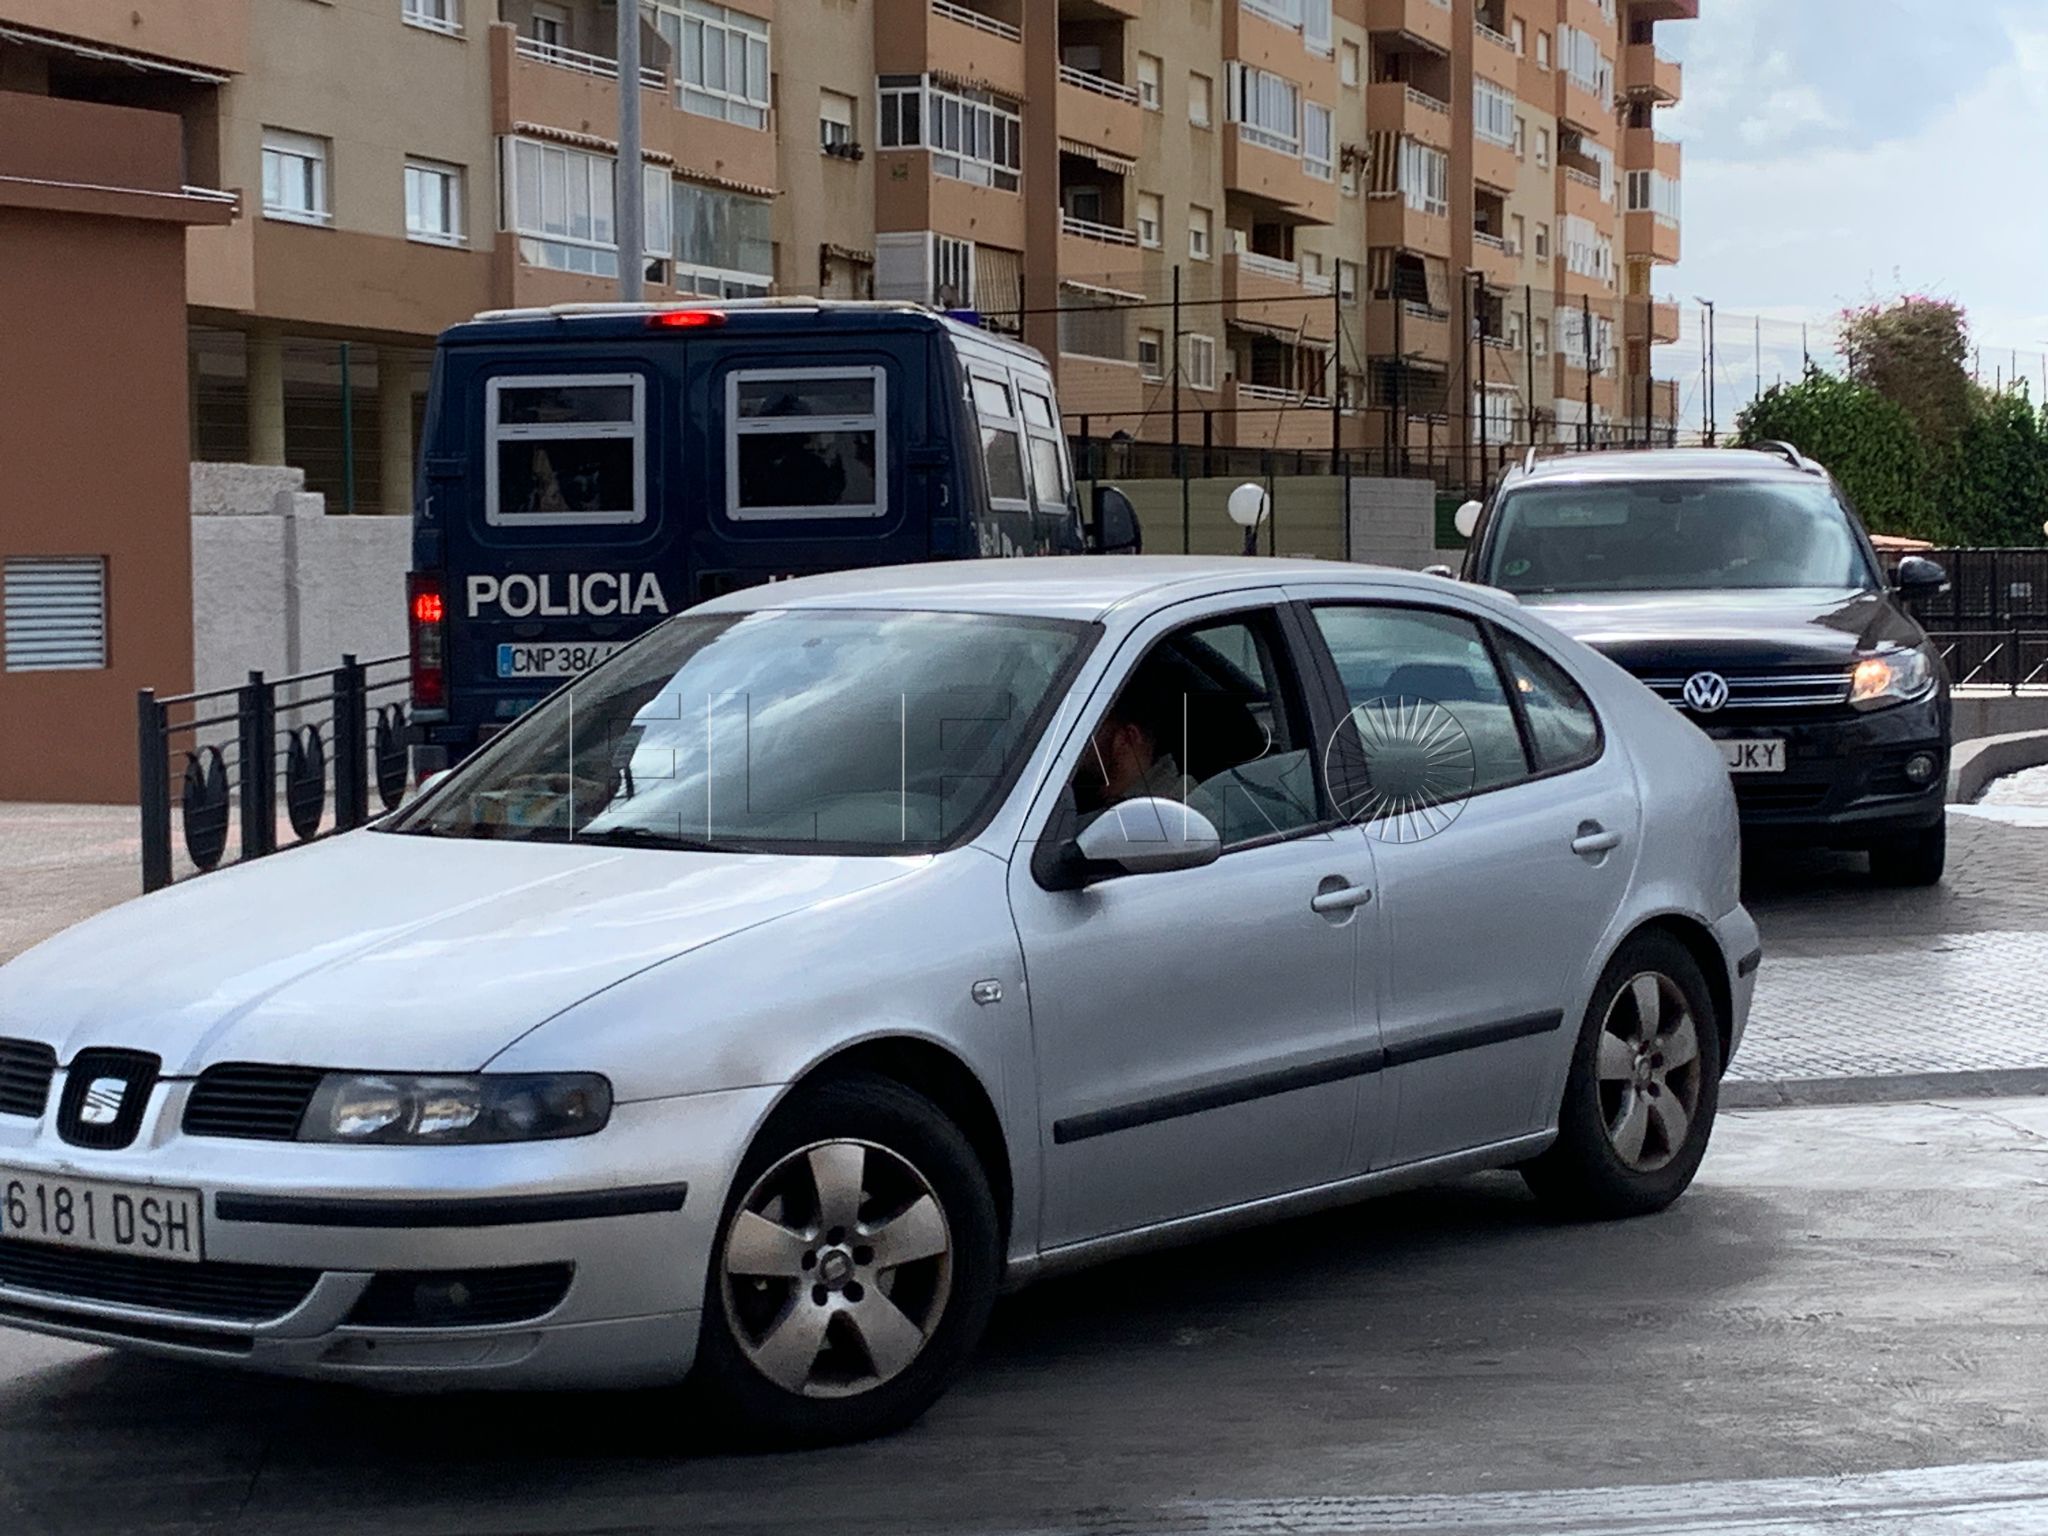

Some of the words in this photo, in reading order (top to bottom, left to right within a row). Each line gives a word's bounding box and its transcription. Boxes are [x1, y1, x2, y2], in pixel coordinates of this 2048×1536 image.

[467, 572, 669, 617] POLICIA
[512, 648, 555, 672] CNP
[1729, 744, 1776, 768] JKY
[7, 1181, 97, 1240] 6181
[112, 1193, 190, 1253] DSH
